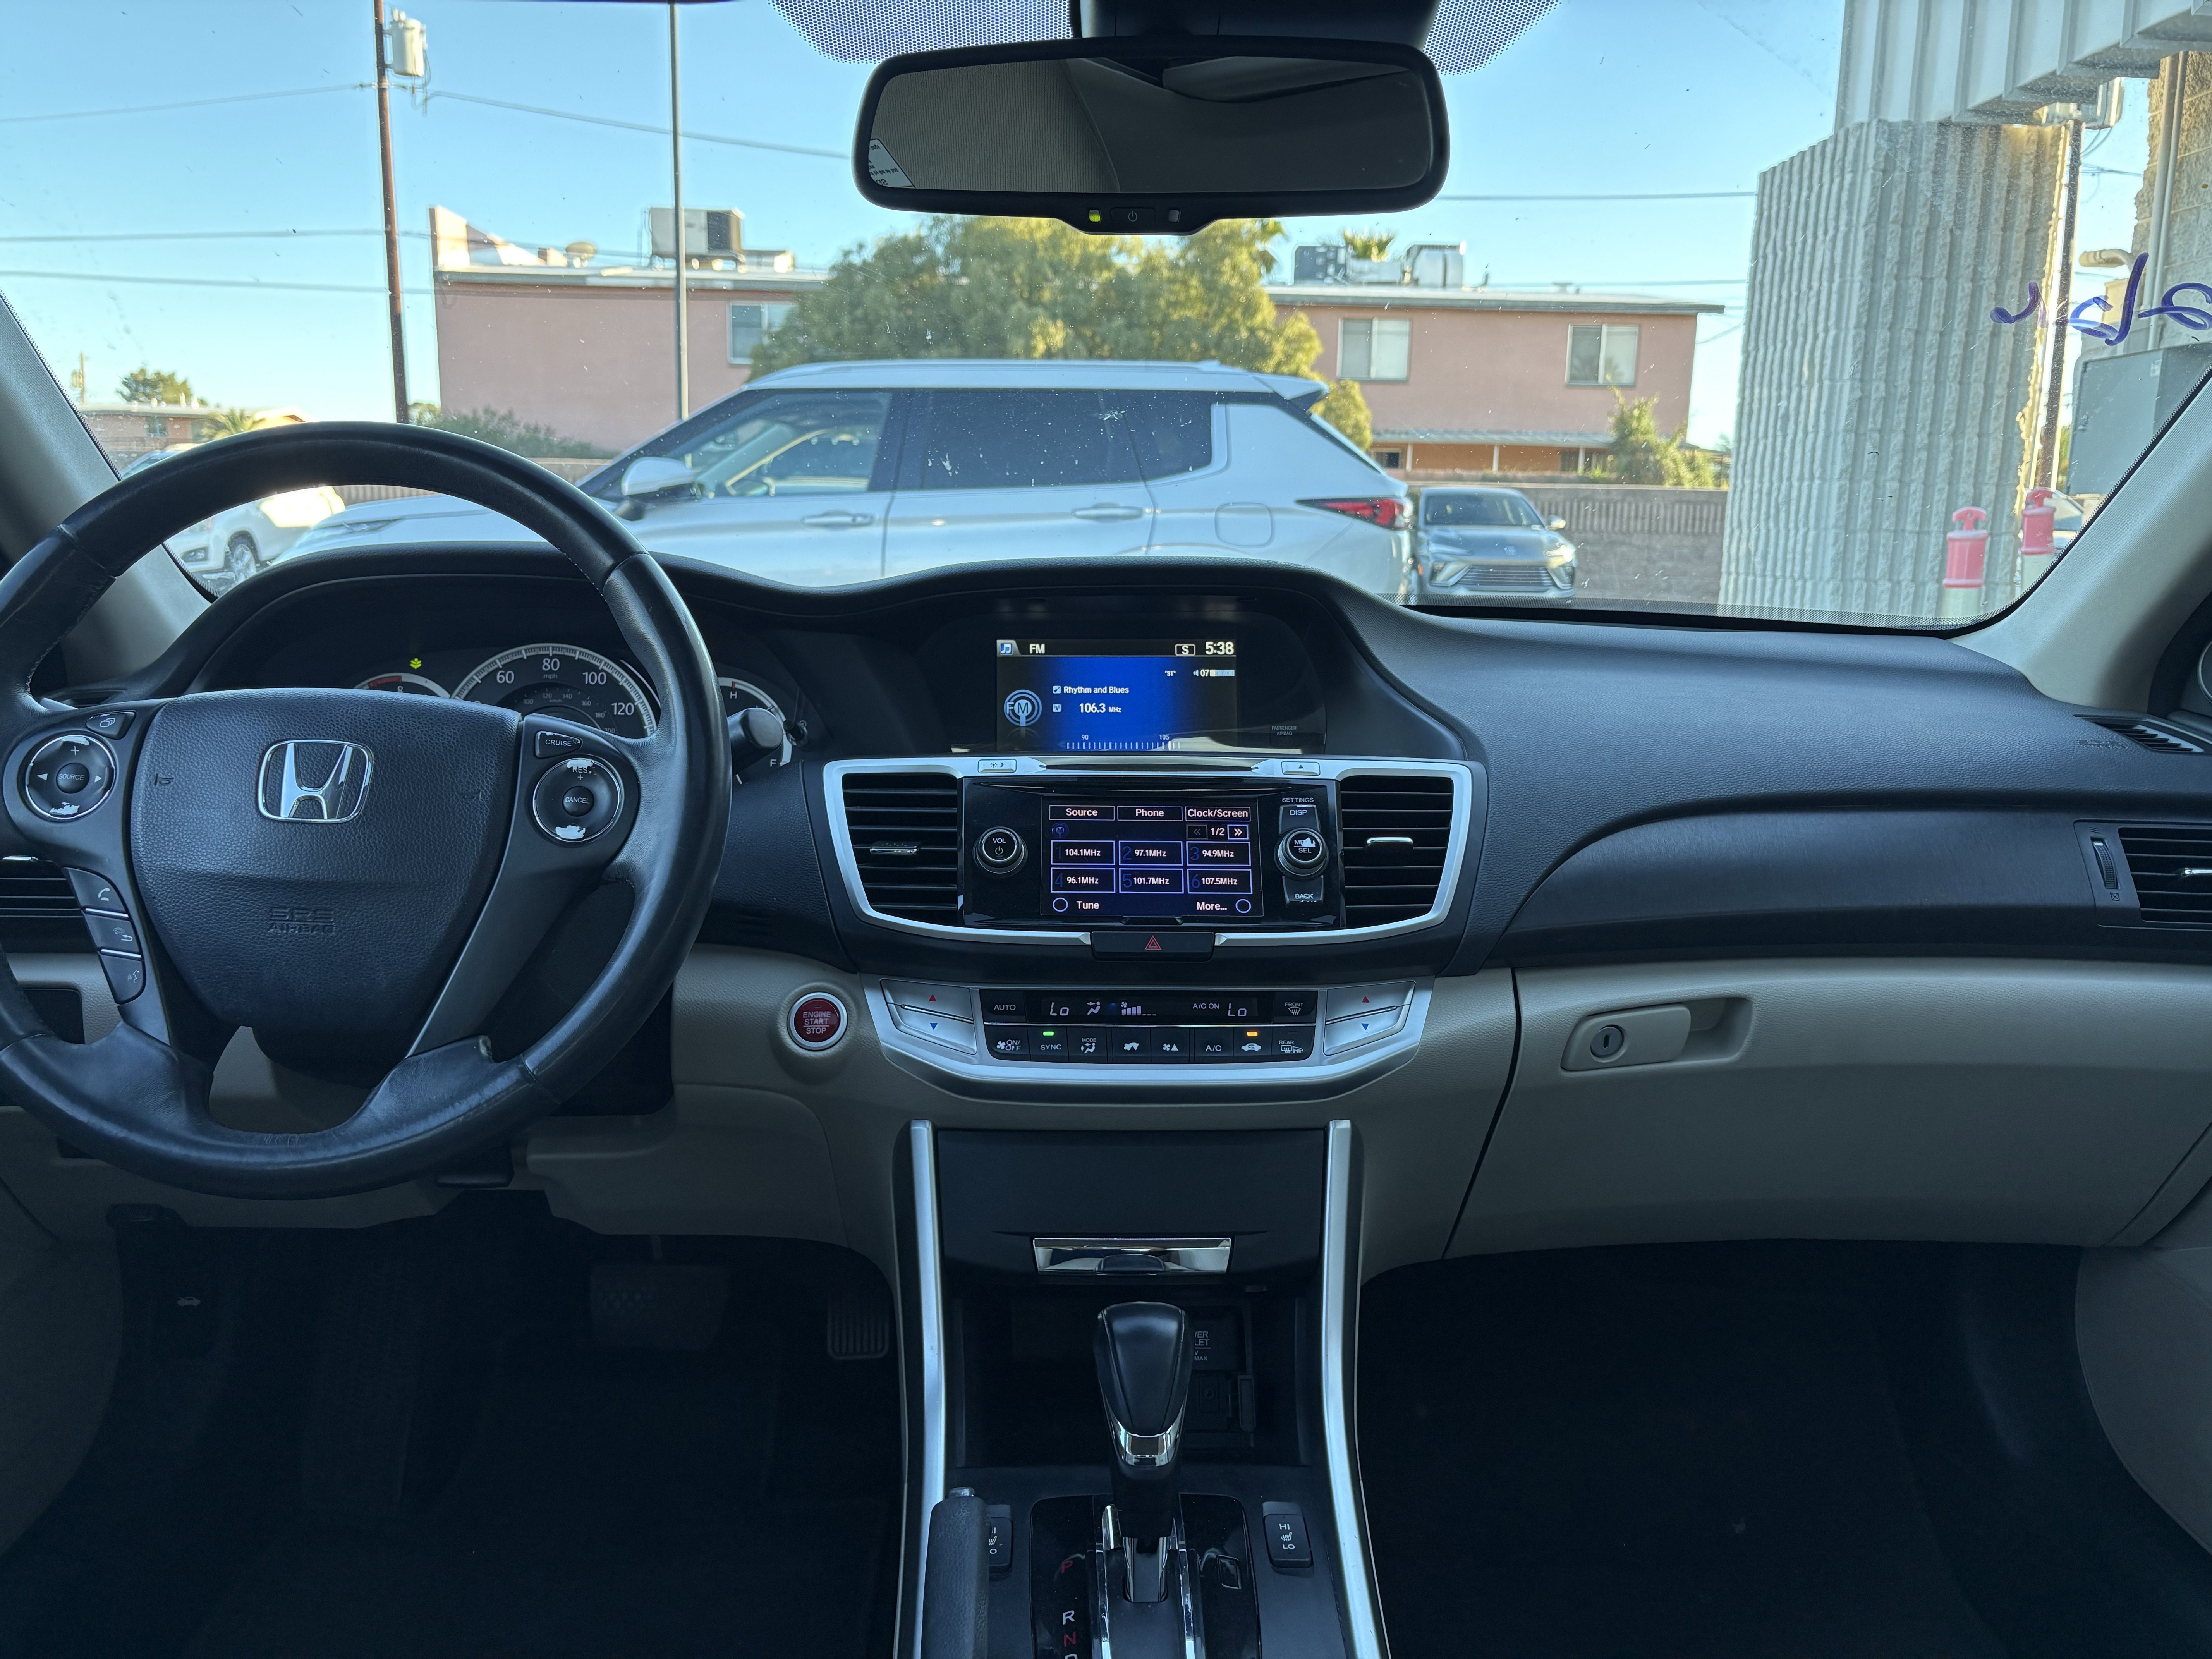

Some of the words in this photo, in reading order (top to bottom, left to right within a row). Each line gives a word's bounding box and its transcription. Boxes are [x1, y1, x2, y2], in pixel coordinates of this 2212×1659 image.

[1029, 644, 1045, 654] FM
[1205, 641, 1234, 655] 5:38
[542, 658, 560, 671] 80
[496, 671, 514, 684] 60
[583, 672, 607, 685] 100
[1063, 686, 1091, 694] Rhythm
[611, 702, 635, 715] 120
[1079, 703, 1106, 713] 106.3
[770, 759, 776, 767] F
[58, 773, 85, 781] SOURCE
[1066, 808, 1098, 817] Source
[1135, 809, 1164, 817] Phone
[1187, 809, 1248, 818] Clock/Screen
[1211, 828, 1225, 836] 1/2
[1065, 848, 1101, 857] 104.1MHz
[1066, 876, 1099, 885] 96.1MHz
[1133, 877, 1169, 885] 101.7MHz
[1201, 877, 1238, 886] 107.5MHz
[1076, 901, 1099, 910] Tune
[1196, 902, 1227, 911] More...
[1061, 1560, 1073, 1574] P
[1062, 1610, 1075, 1626] R
[1063, 1631, 1077, 1648] N
